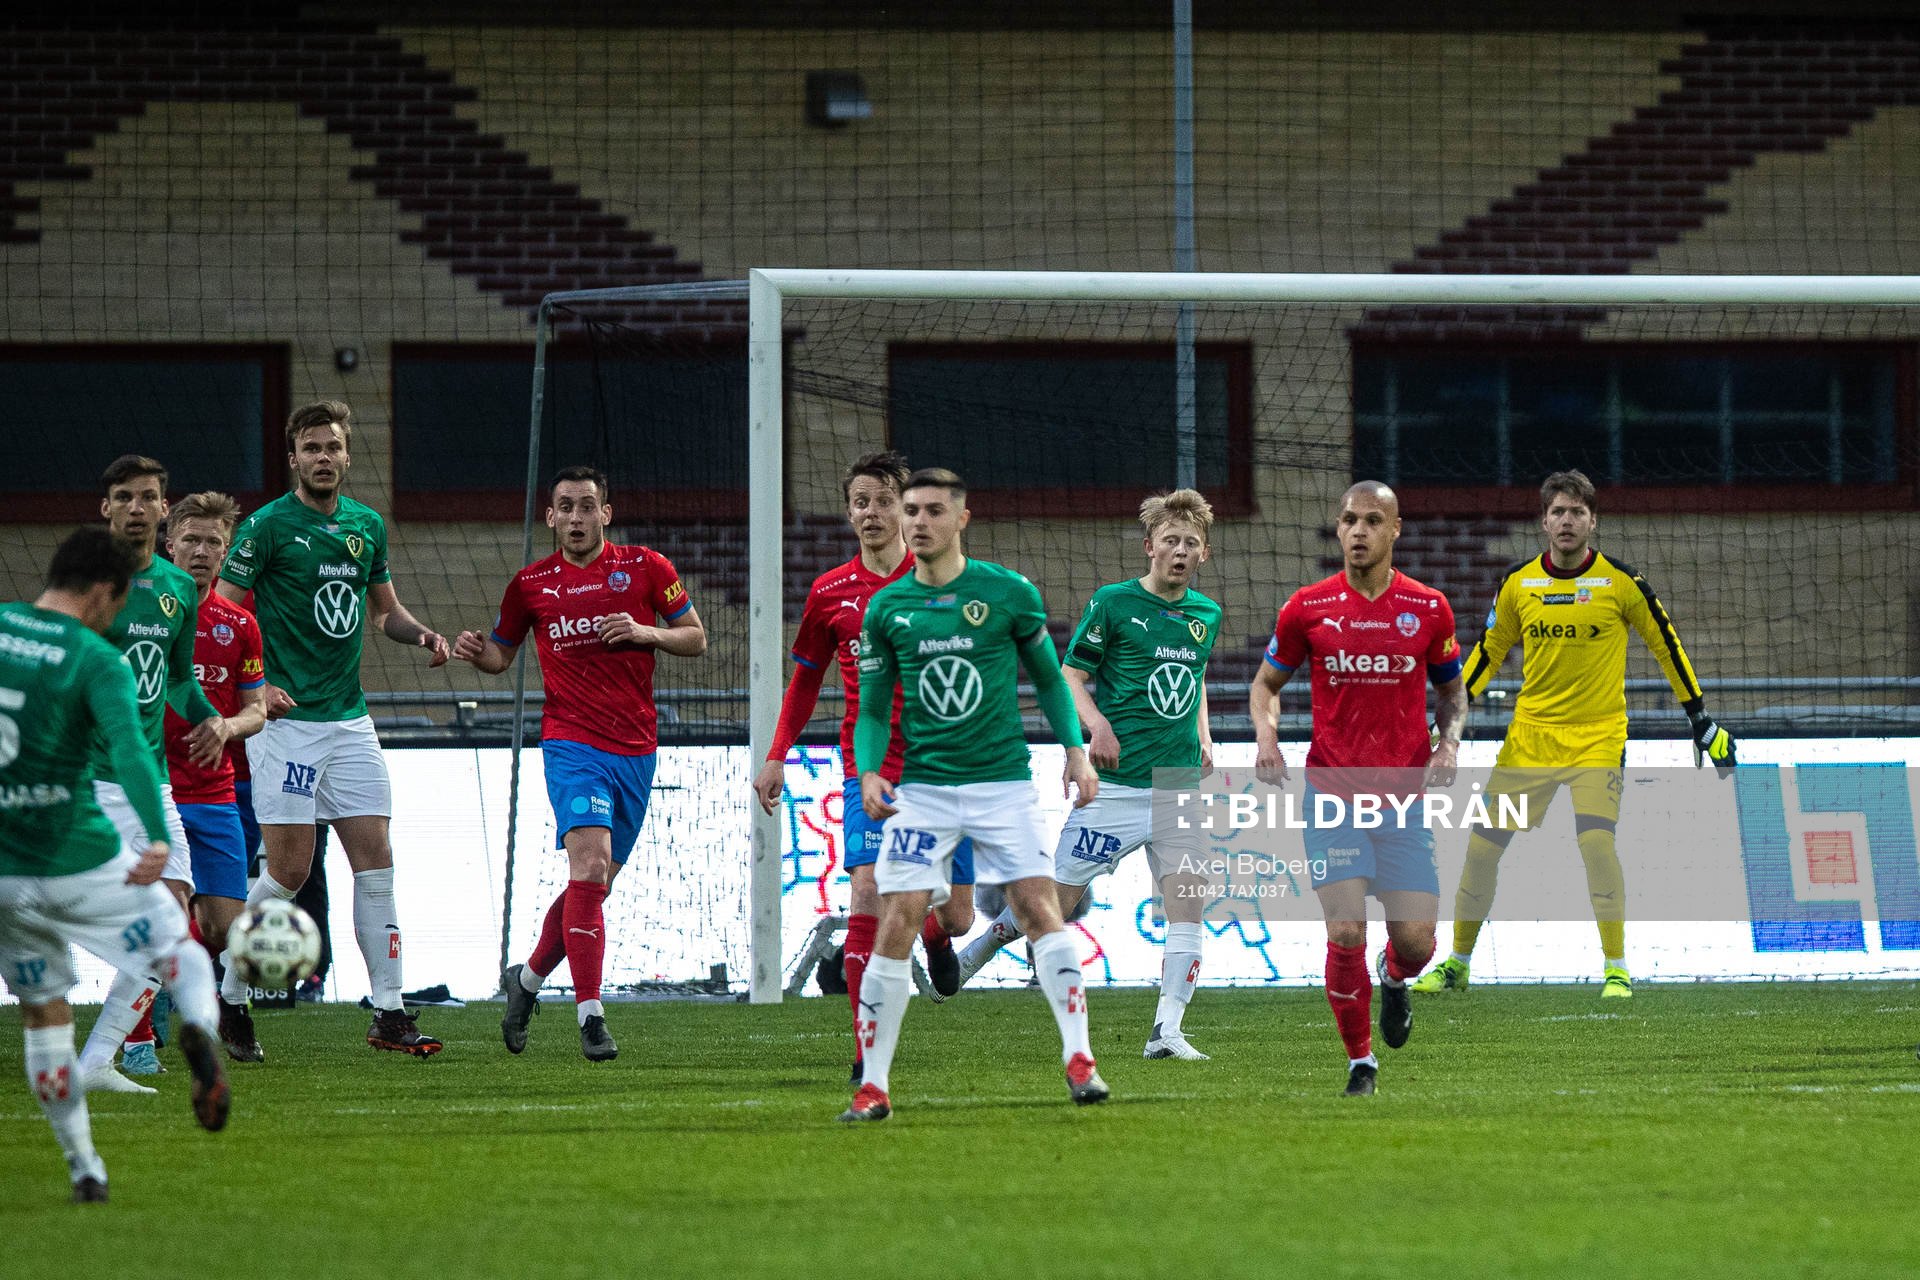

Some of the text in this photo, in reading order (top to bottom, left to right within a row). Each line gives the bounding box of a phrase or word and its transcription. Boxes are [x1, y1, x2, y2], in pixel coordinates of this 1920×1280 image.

[318, 564, 358, 577] Atteviks
[128, 622, 169, 637] Atteviks
[1529, 620, 1576, 638] akea
[918, 636, 974, 655] Atteviks
[1155, 646, 1197, 660] Atteviks
[1324, 649, 1390, 673] akea
[888, 827, 937, 857] NP
[1073, 826, 1122, 858] NP
